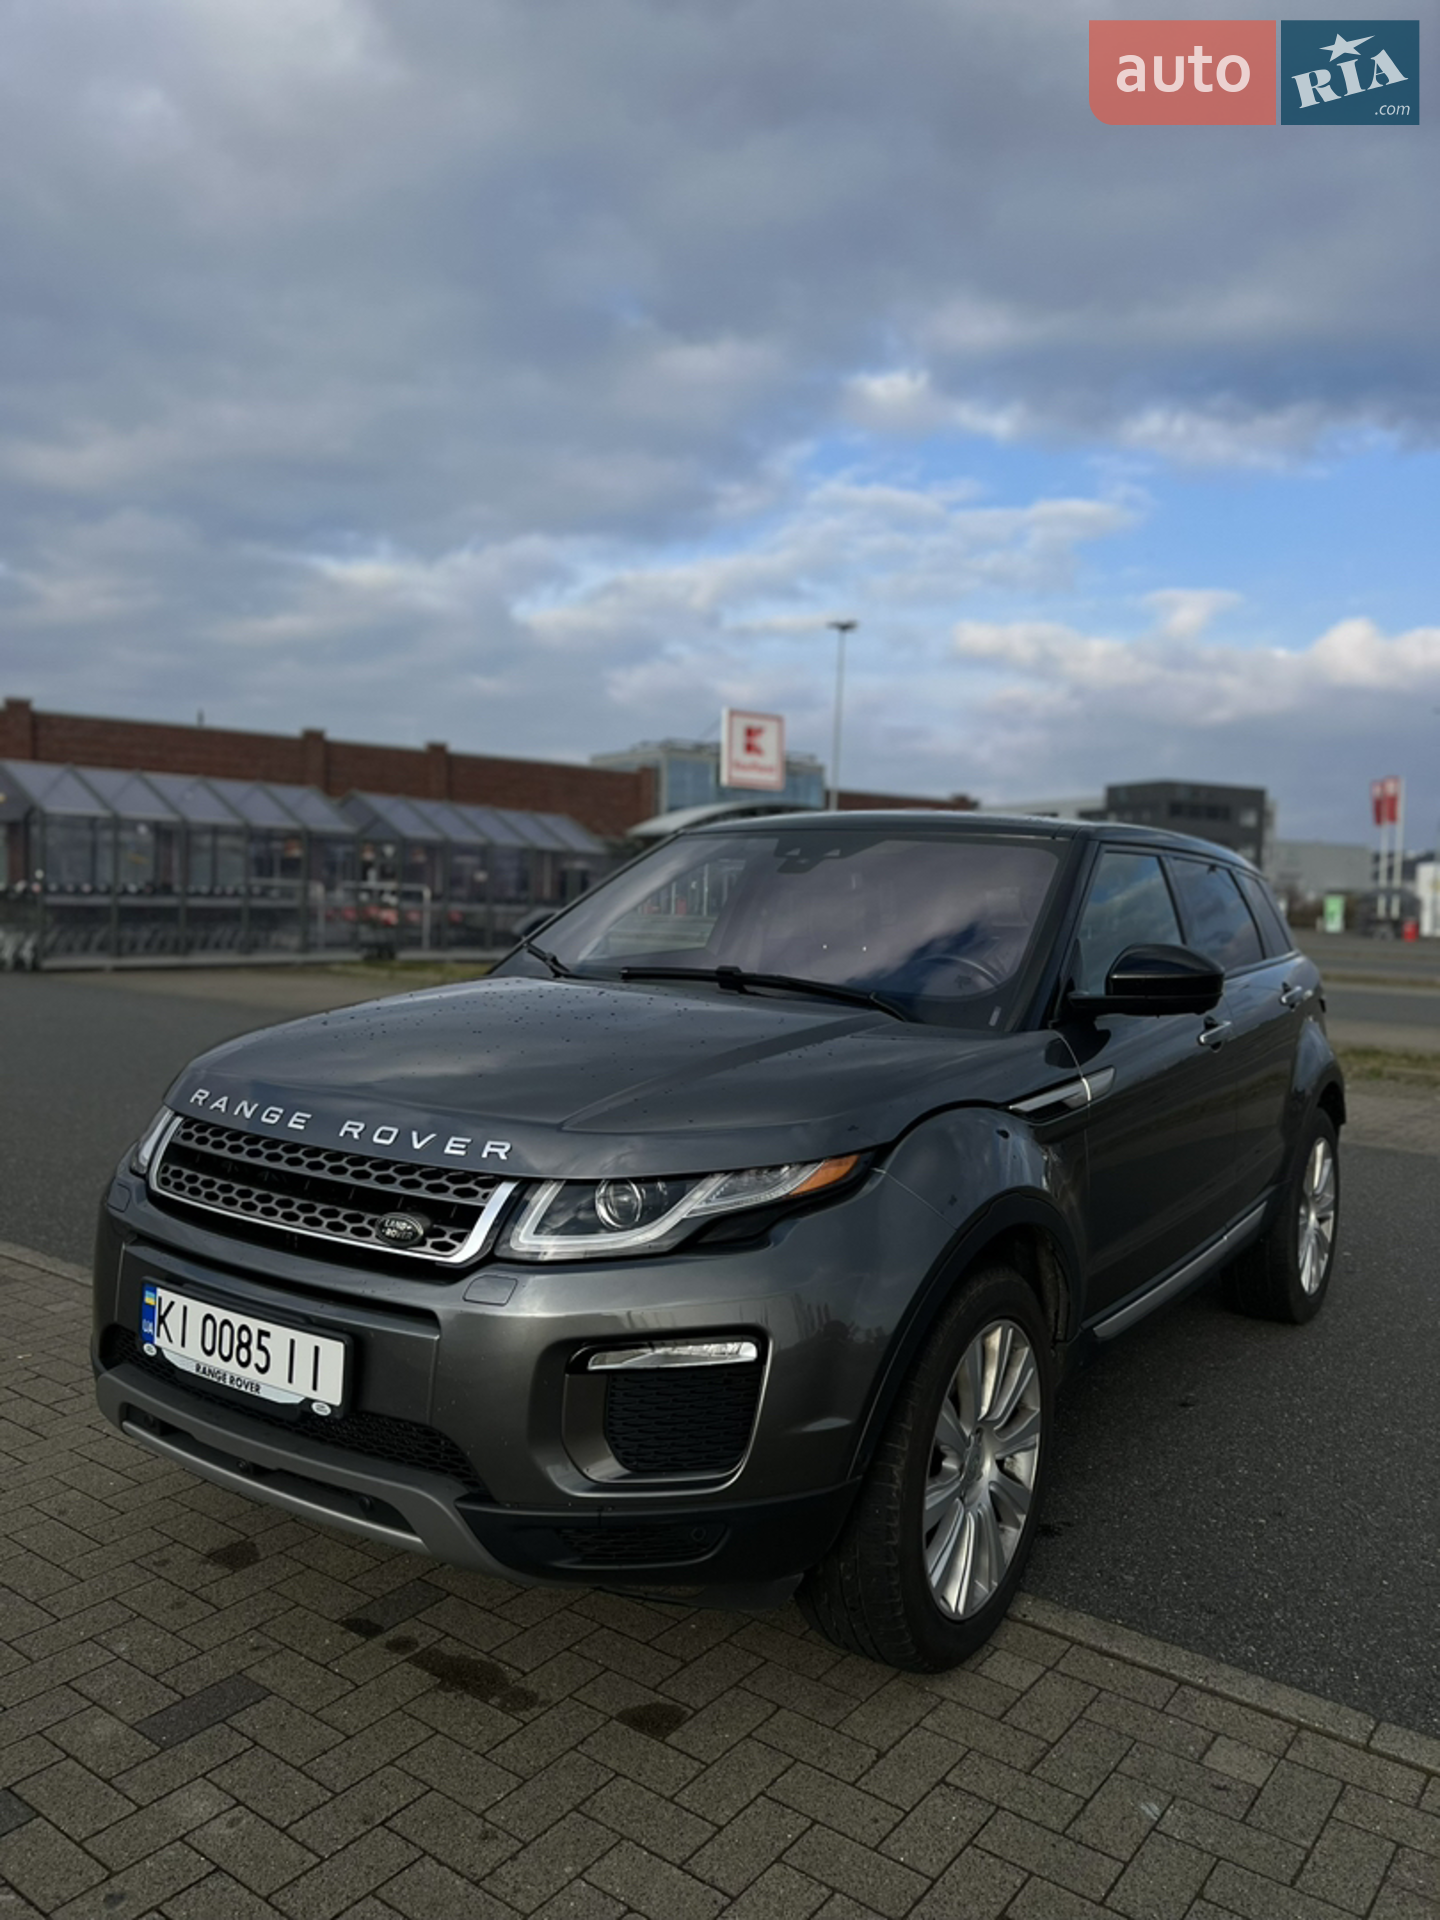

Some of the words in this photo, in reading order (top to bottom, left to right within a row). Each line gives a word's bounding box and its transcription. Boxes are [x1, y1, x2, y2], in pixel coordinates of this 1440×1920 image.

[189, 1088, 312, 1130] RANGE
[338, 1120, 512, 1160] ROVER
[156, 1295, 188, 1348] KI
[200, 1313, 271, 1375] 0085
[195, 1363, 227, 1385] RANGE
[229, 1375, 261, 1395] ROVER
